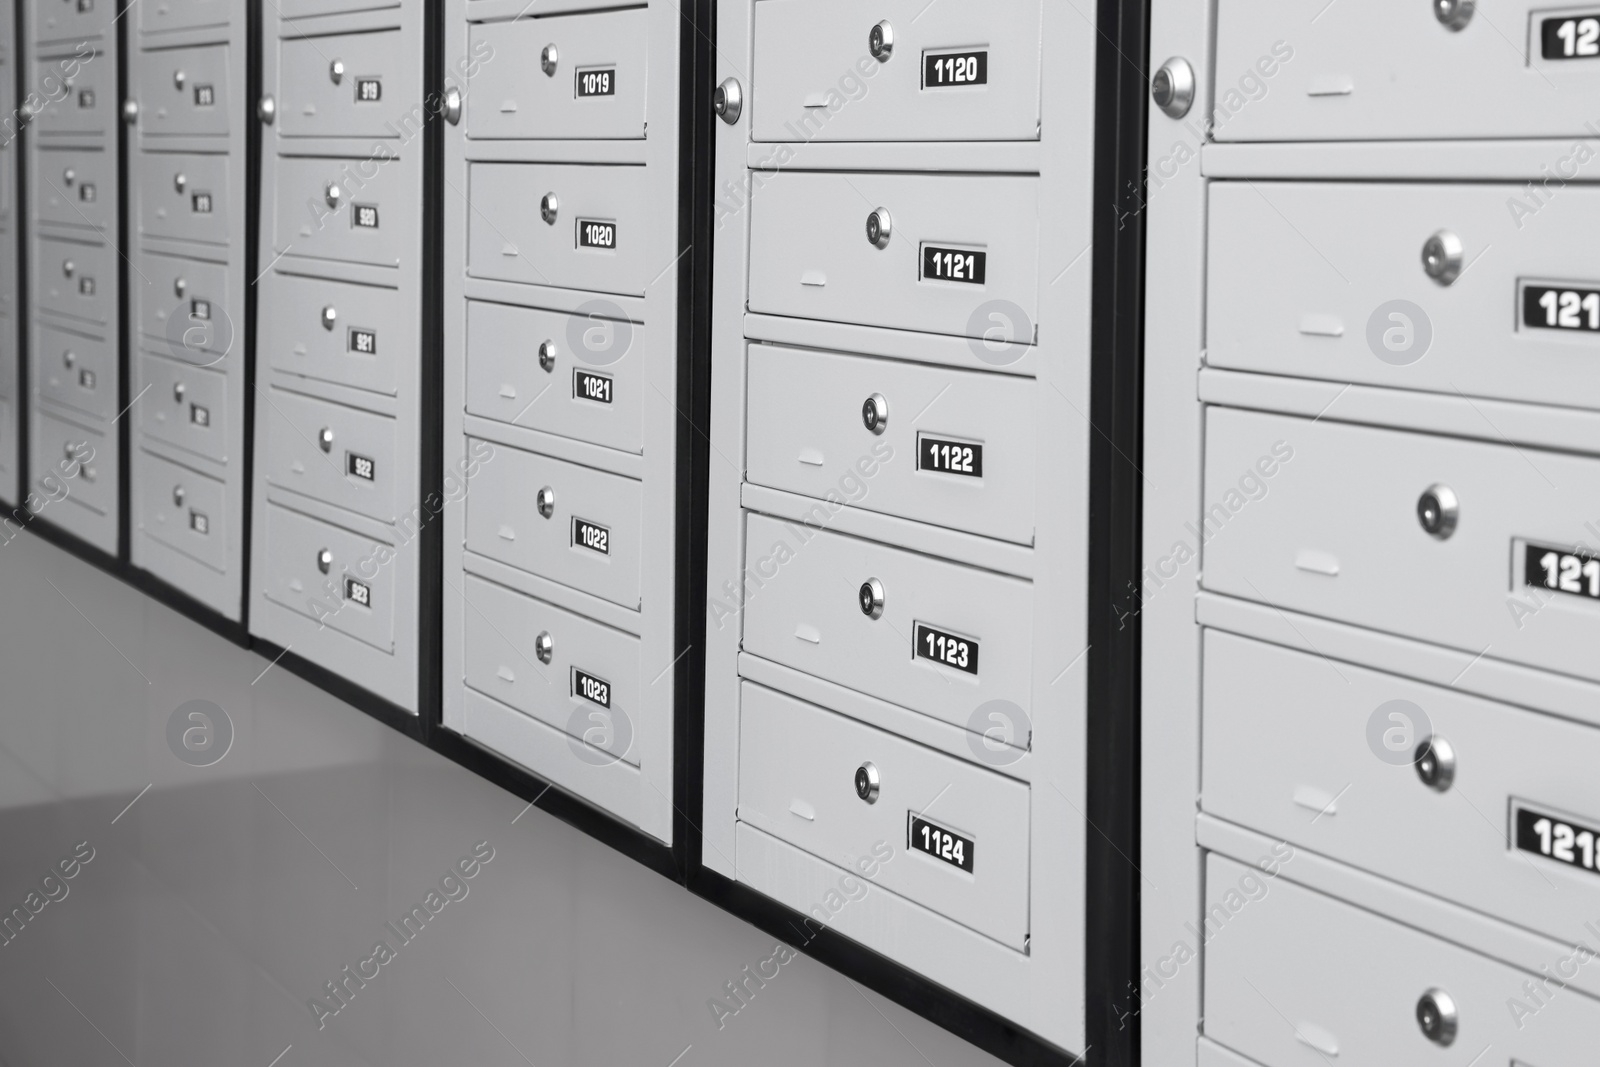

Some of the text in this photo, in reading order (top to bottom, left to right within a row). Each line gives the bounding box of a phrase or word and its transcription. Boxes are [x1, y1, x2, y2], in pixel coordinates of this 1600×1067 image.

[934, 56, 978, 83] 1120
[583, 73, 610, 94] 1019
[585, 224, 613, 246] 1020
[932, 252, 975, 280] 1121
[583, 376, 610, 401] 1021
[929, 443, 974, 473] 1122
[581, 525, 608, 552] 1022
[925, 632, 969, 668] 1123
[581, 677, 608, 705] 1023
[921, 825, 965, 865] 1124
